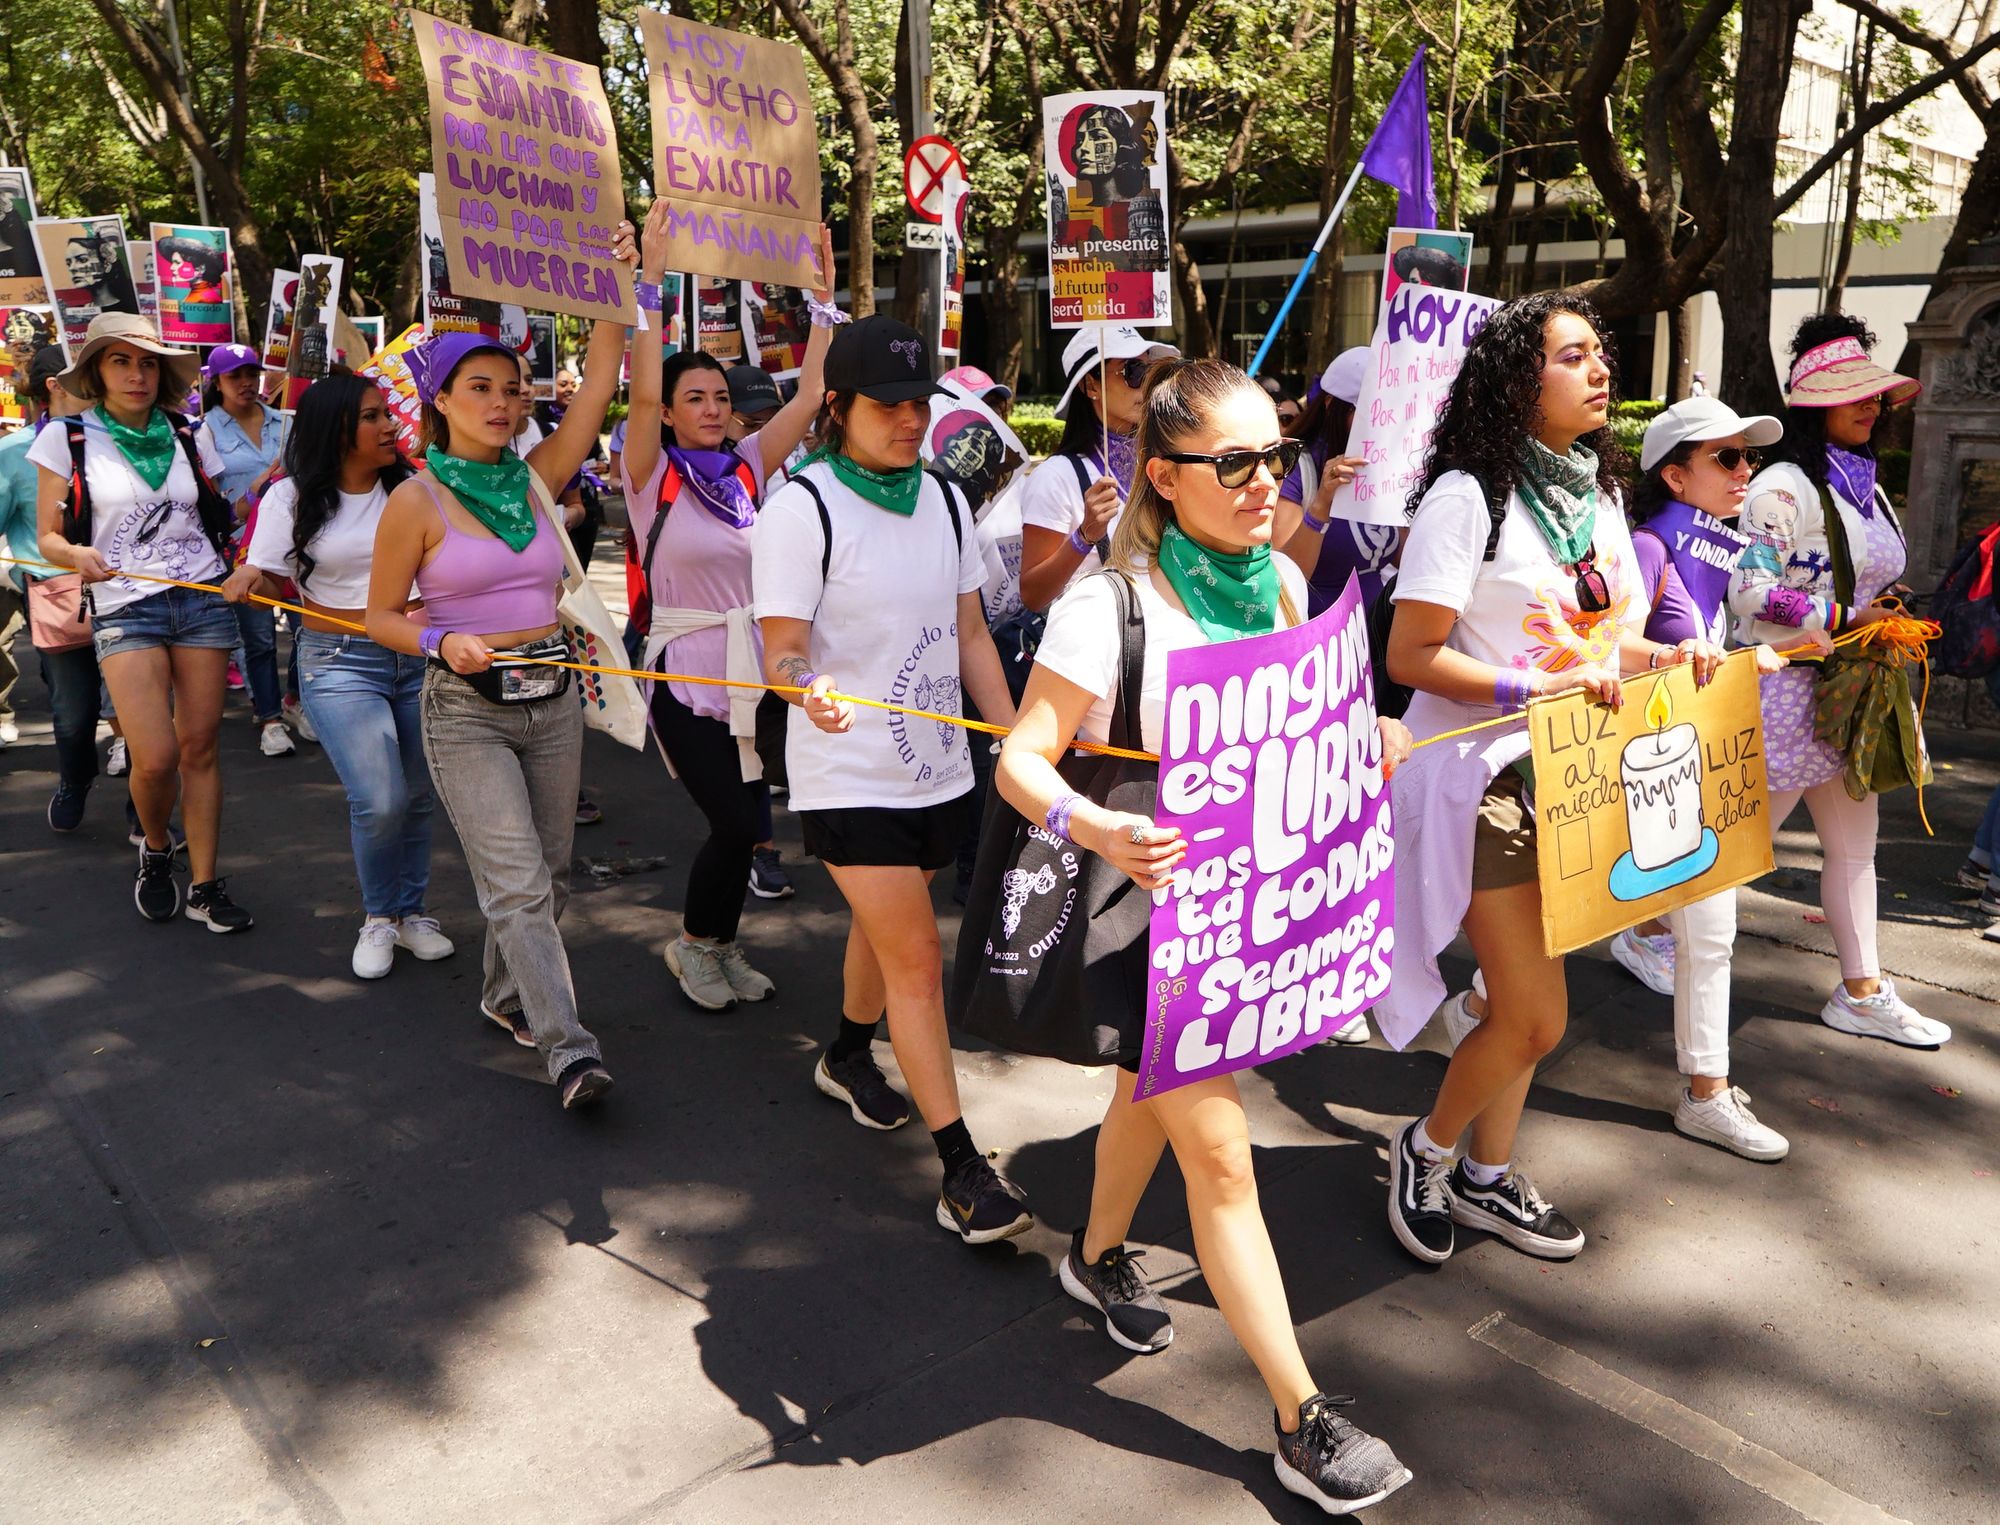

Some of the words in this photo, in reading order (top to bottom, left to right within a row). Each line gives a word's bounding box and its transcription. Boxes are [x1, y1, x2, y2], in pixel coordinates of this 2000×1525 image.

[433, 20, 537, 77] PORQUE
[545, 58, 589, 91] TE
[664, 24, 747, 72] HOY
[440, 55, 607, 147] ESPANTAS
[663, 63, 798, 126] LUCHO
[444, 112, 493, 156] POR
[501, 130, 541, 167] LAS
[550, 143, 600, 179] QUE
[666, 106, 752, 152] PARA
[447, 153, 574, 212] LUCHAN
[581, 185, 598, 214] Y
[666, 146, 800, 208] EXISTIR
[459, 198, 498, 232] NO
[512, 213, 572, 253] POR
[577, 222, 610, 242] LAS
[668, 207, 821, 271] MAÑANA
[1083, 238, 1160, 257] presente
[464, 236, 622, 307] MUEREN
[1053, 280, 1064, 296] el
[1066, 277, 1119, 295] futuro
[1068, 256, 1115, 274] lucha
[431, 313, 480, 329] porque
[699, 321, 737, 332] Ardemos
[1053, 300, 1083, 316] será
[1087, 298, 1126, 316] vida
[1388, 288, 1461, 347] HOY
[699, 335, 721, 345] para
[1405, 393, 1417, 421] mi
[1382, 473, 1396, 495] mi
[1674, 531, 1690, 551] Y
[1168, 601, 1370, 762] ninguna
[1547, 703, 1617, 754] LUZ
[1707, 727, 1758, 772] LUZ
[1162, 745, 1251, 817] es
[1565, 747, 1607, 788] al
[1719, 764, 1756, 800] al
[1546, 775, 1622, 824] miedo
[1715, 799, 1761, 833] dolor
[1062, 851, 1079, 879] en
[1029, 887, 1077, 958] camino
[1177, 888, 1245, 937] ta
[1152, 922, 1243, 978] que
[1174, 926, 1395, 1074] LIBRES
